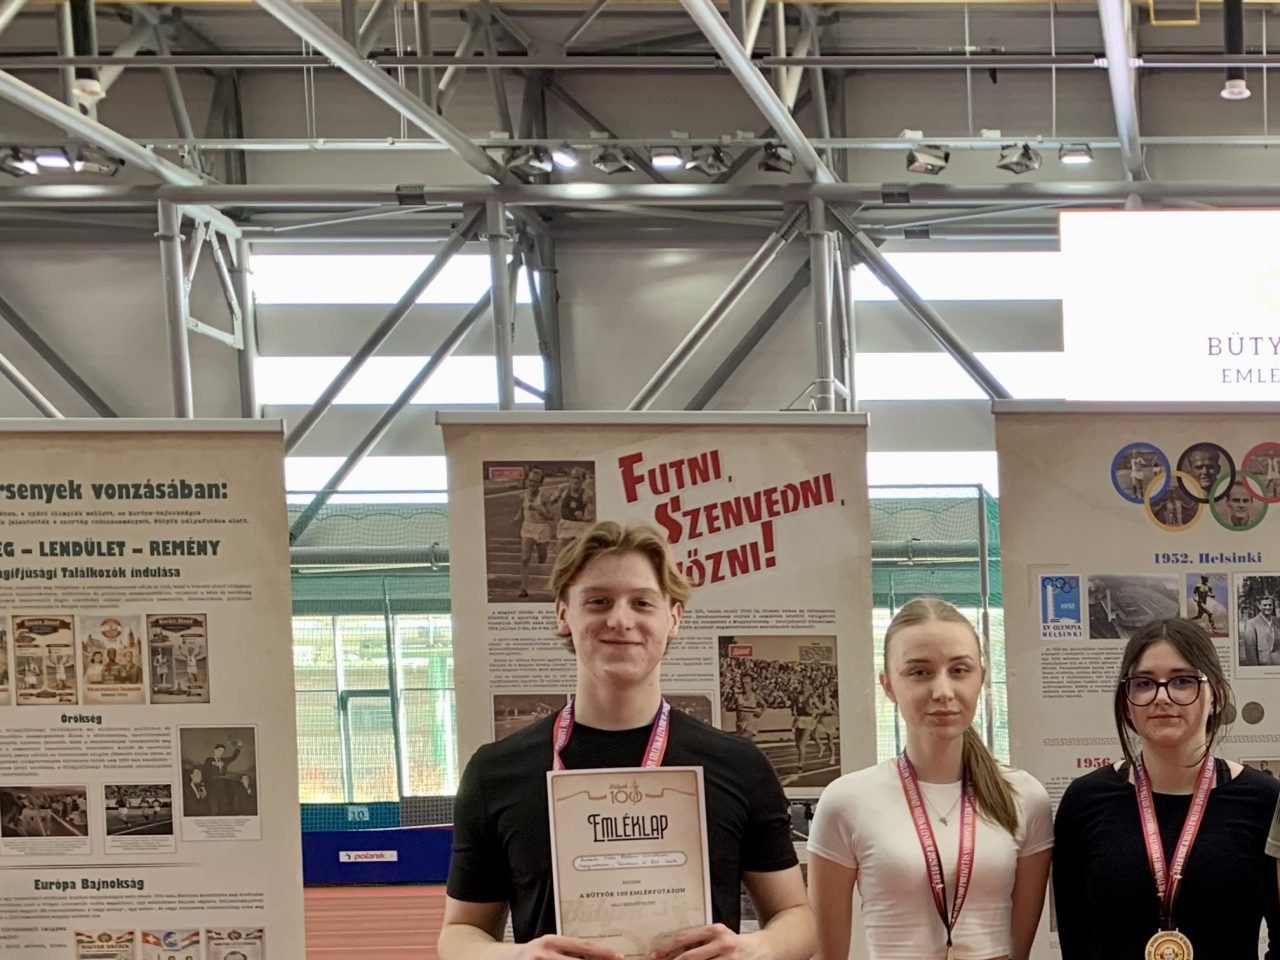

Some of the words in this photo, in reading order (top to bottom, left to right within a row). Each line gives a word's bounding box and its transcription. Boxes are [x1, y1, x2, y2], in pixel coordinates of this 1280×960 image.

[91, 480, 228, 499] vonzásában:
[39, 537, 126, 557] LENDÜLET
[150, 537, 221, 557] REMÉNY
[1154, 552, 1194, 565] 1952.
[1199, 552, 1262, 564] Helsinki
[61, 566, 126, 579] Találkozók
[130, 566, 181, 579] indulása
[588, 813, 668, 842] EMLÉKLAP
[34, 879, 77, 891] Európa
[81, 877, 145, 892] Bajnokság
